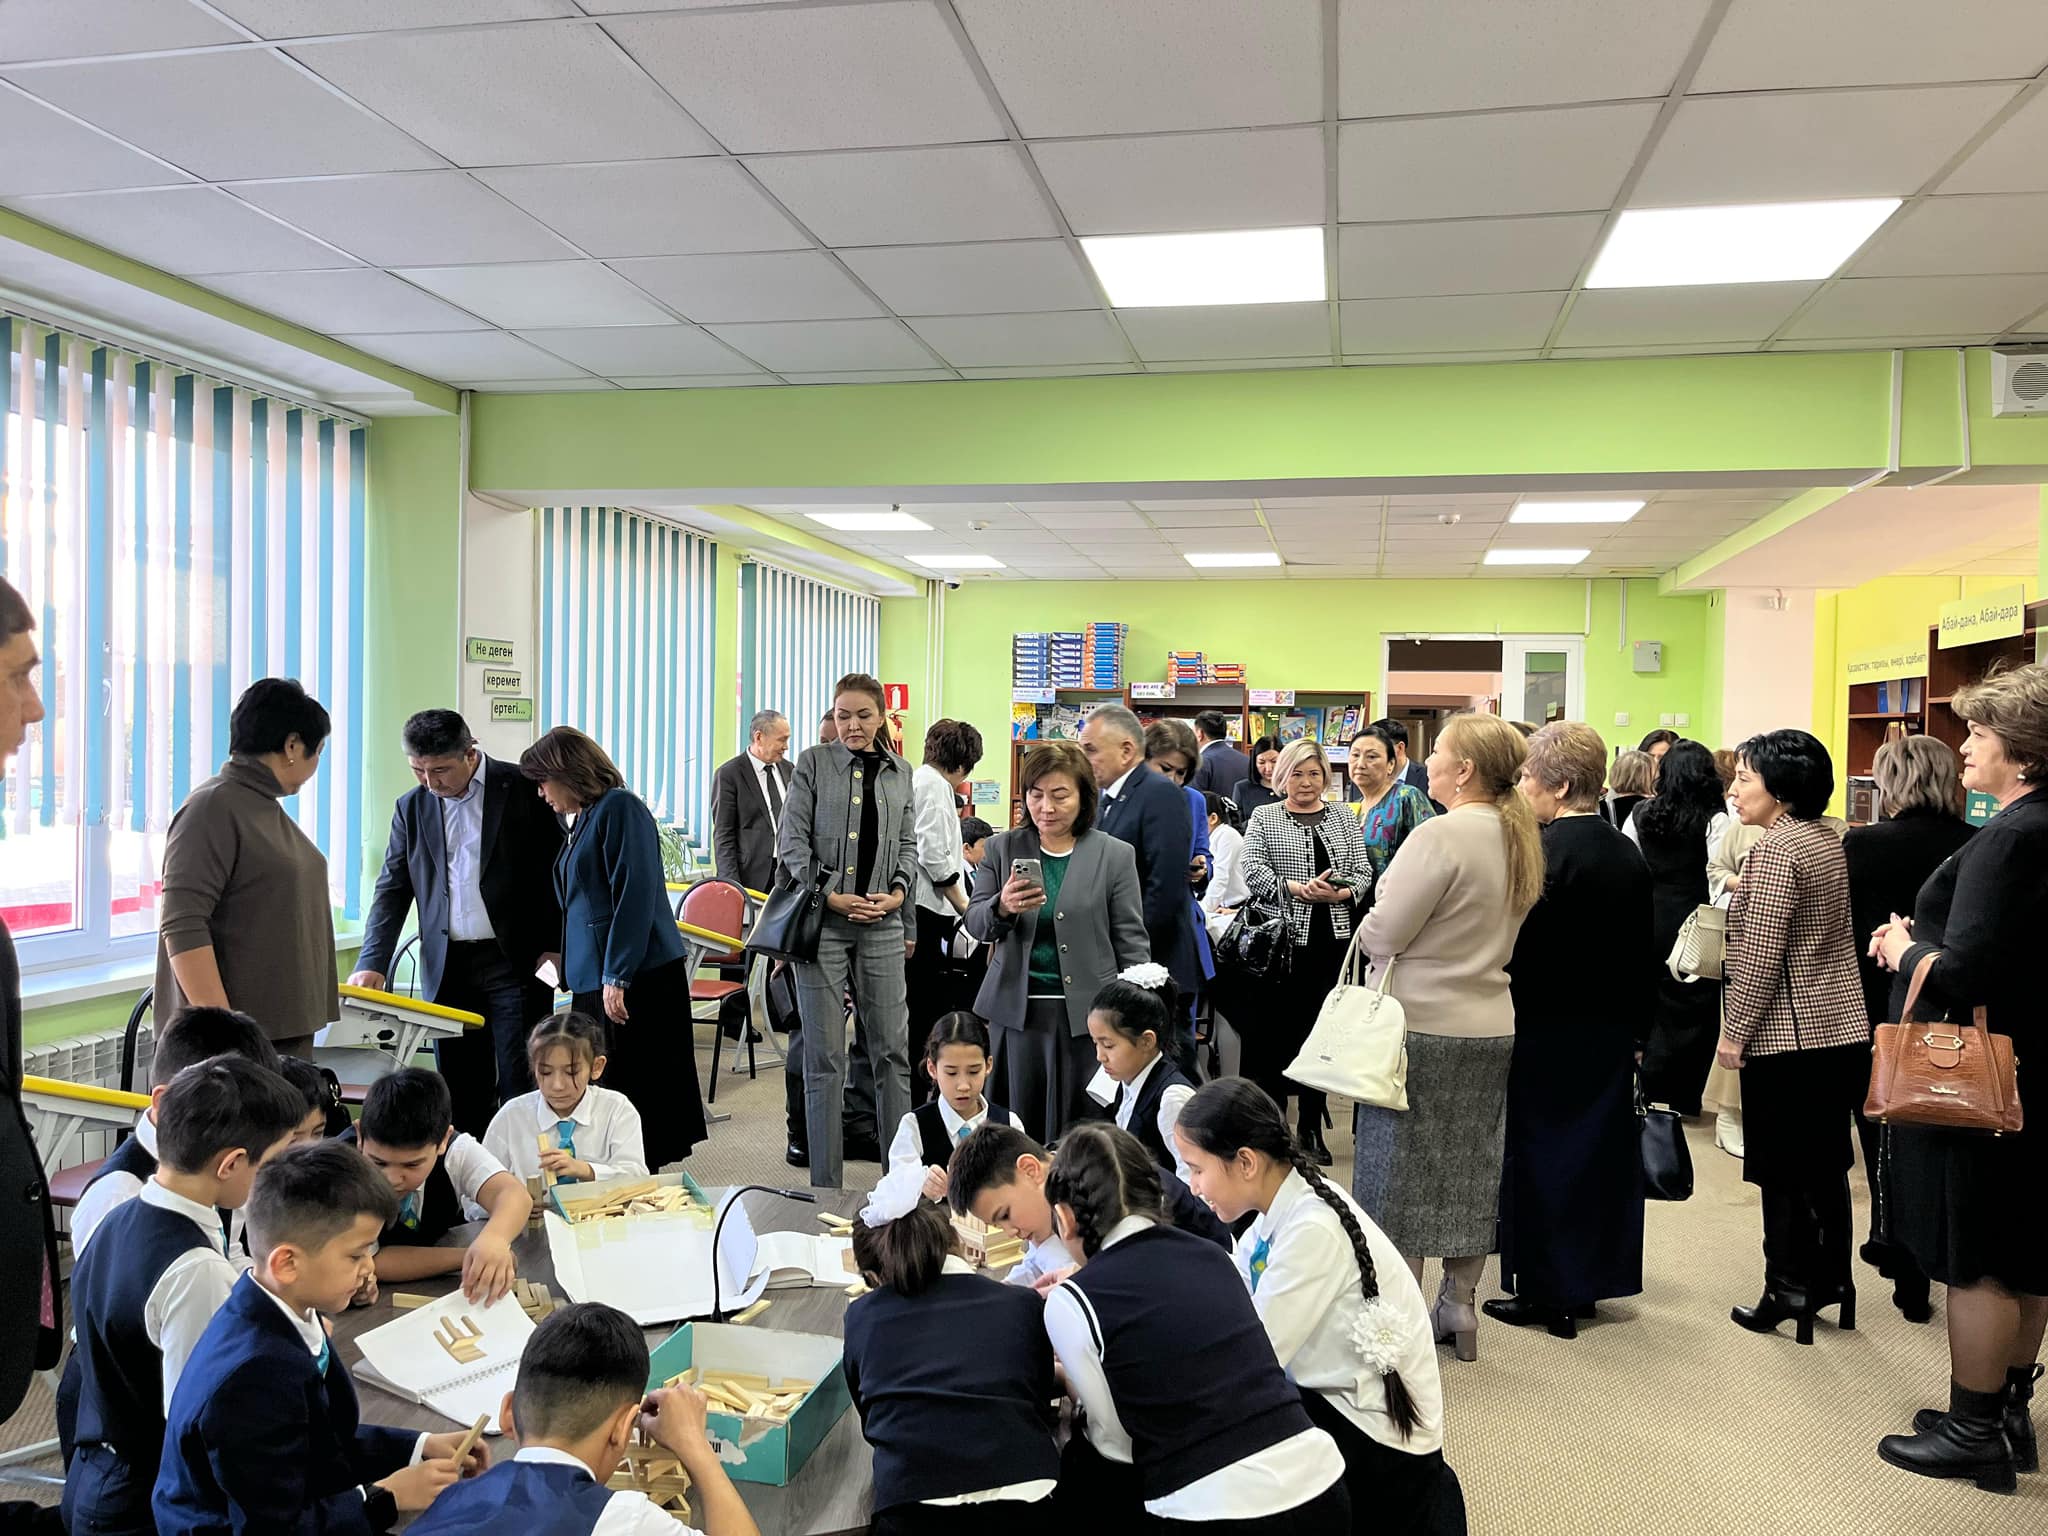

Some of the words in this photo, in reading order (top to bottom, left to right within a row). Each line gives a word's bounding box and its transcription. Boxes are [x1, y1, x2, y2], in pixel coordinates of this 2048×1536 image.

[1980, 605, 2018, 625] Абай-дара
[476, 643, 487, 655] Не
[489, 646, 513, 658] деген
[487, 675, 520, 688] керемет
[494, 702, 526, 716] ертегі...
